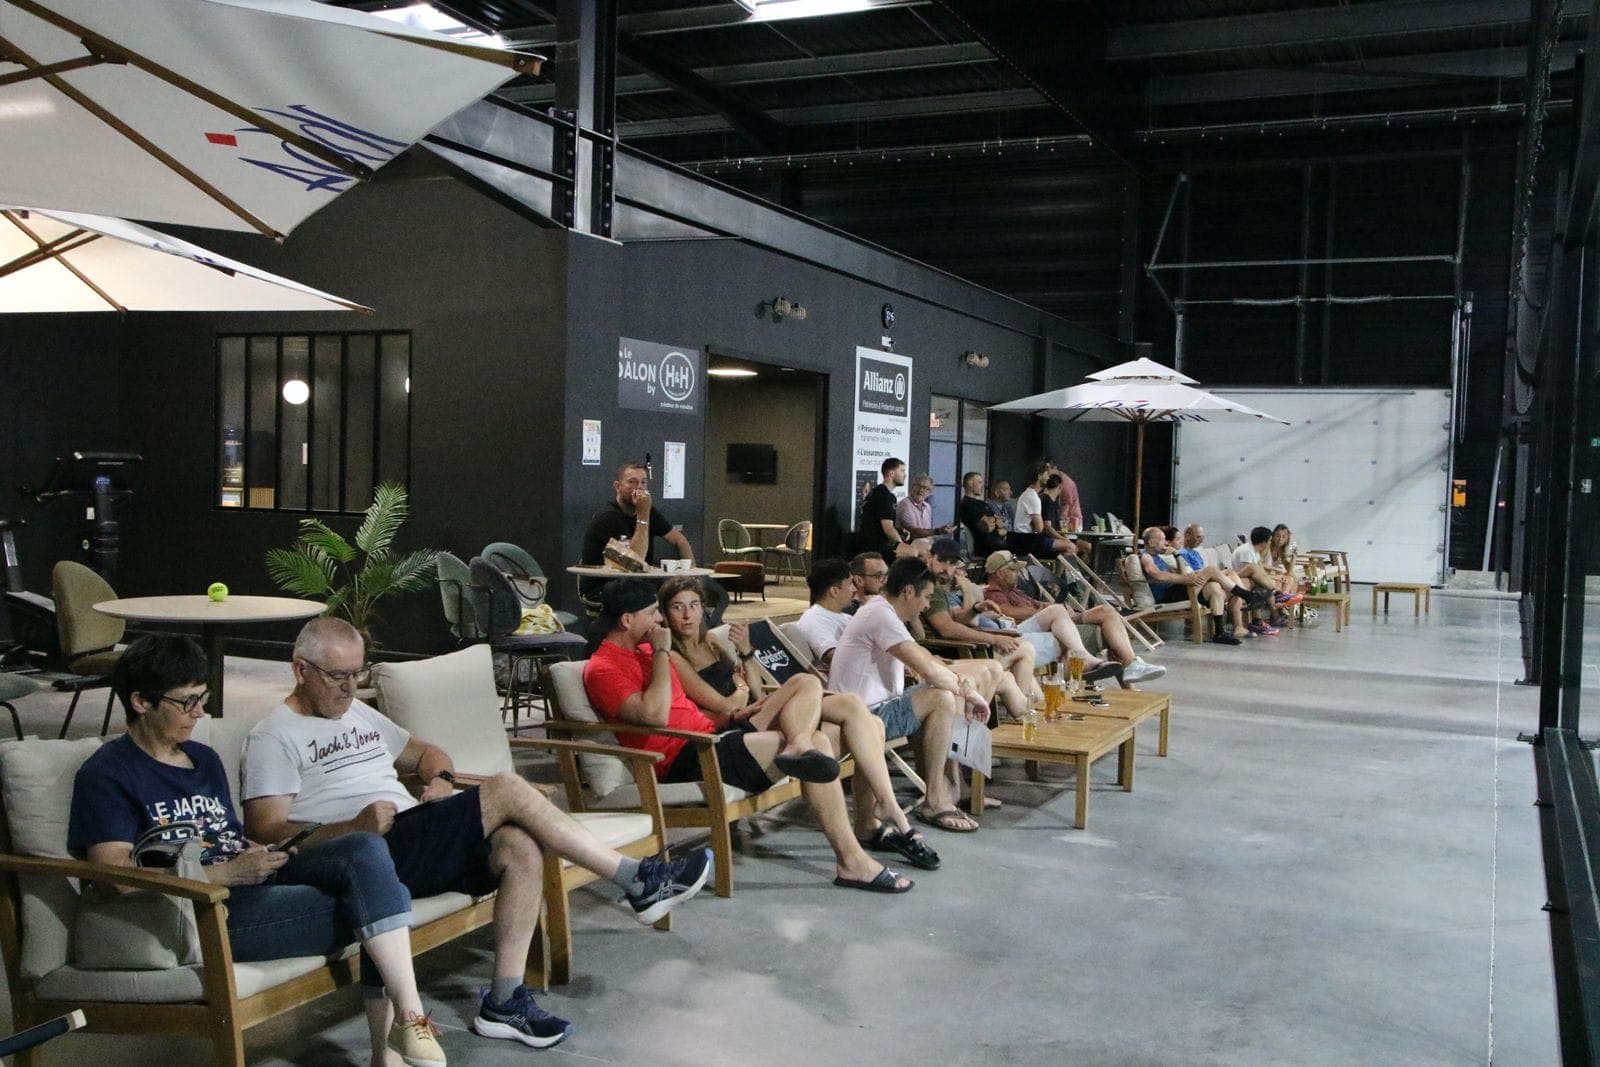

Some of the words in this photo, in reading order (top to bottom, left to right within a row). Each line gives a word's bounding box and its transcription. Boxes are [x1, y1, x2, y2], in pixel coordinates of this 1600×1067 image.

[624, 347, 632, 359] Le
[666, 364, 689, 389] H&H
[863, 370, 893, 394] Allianz
[647, 383, 656, 396] by
